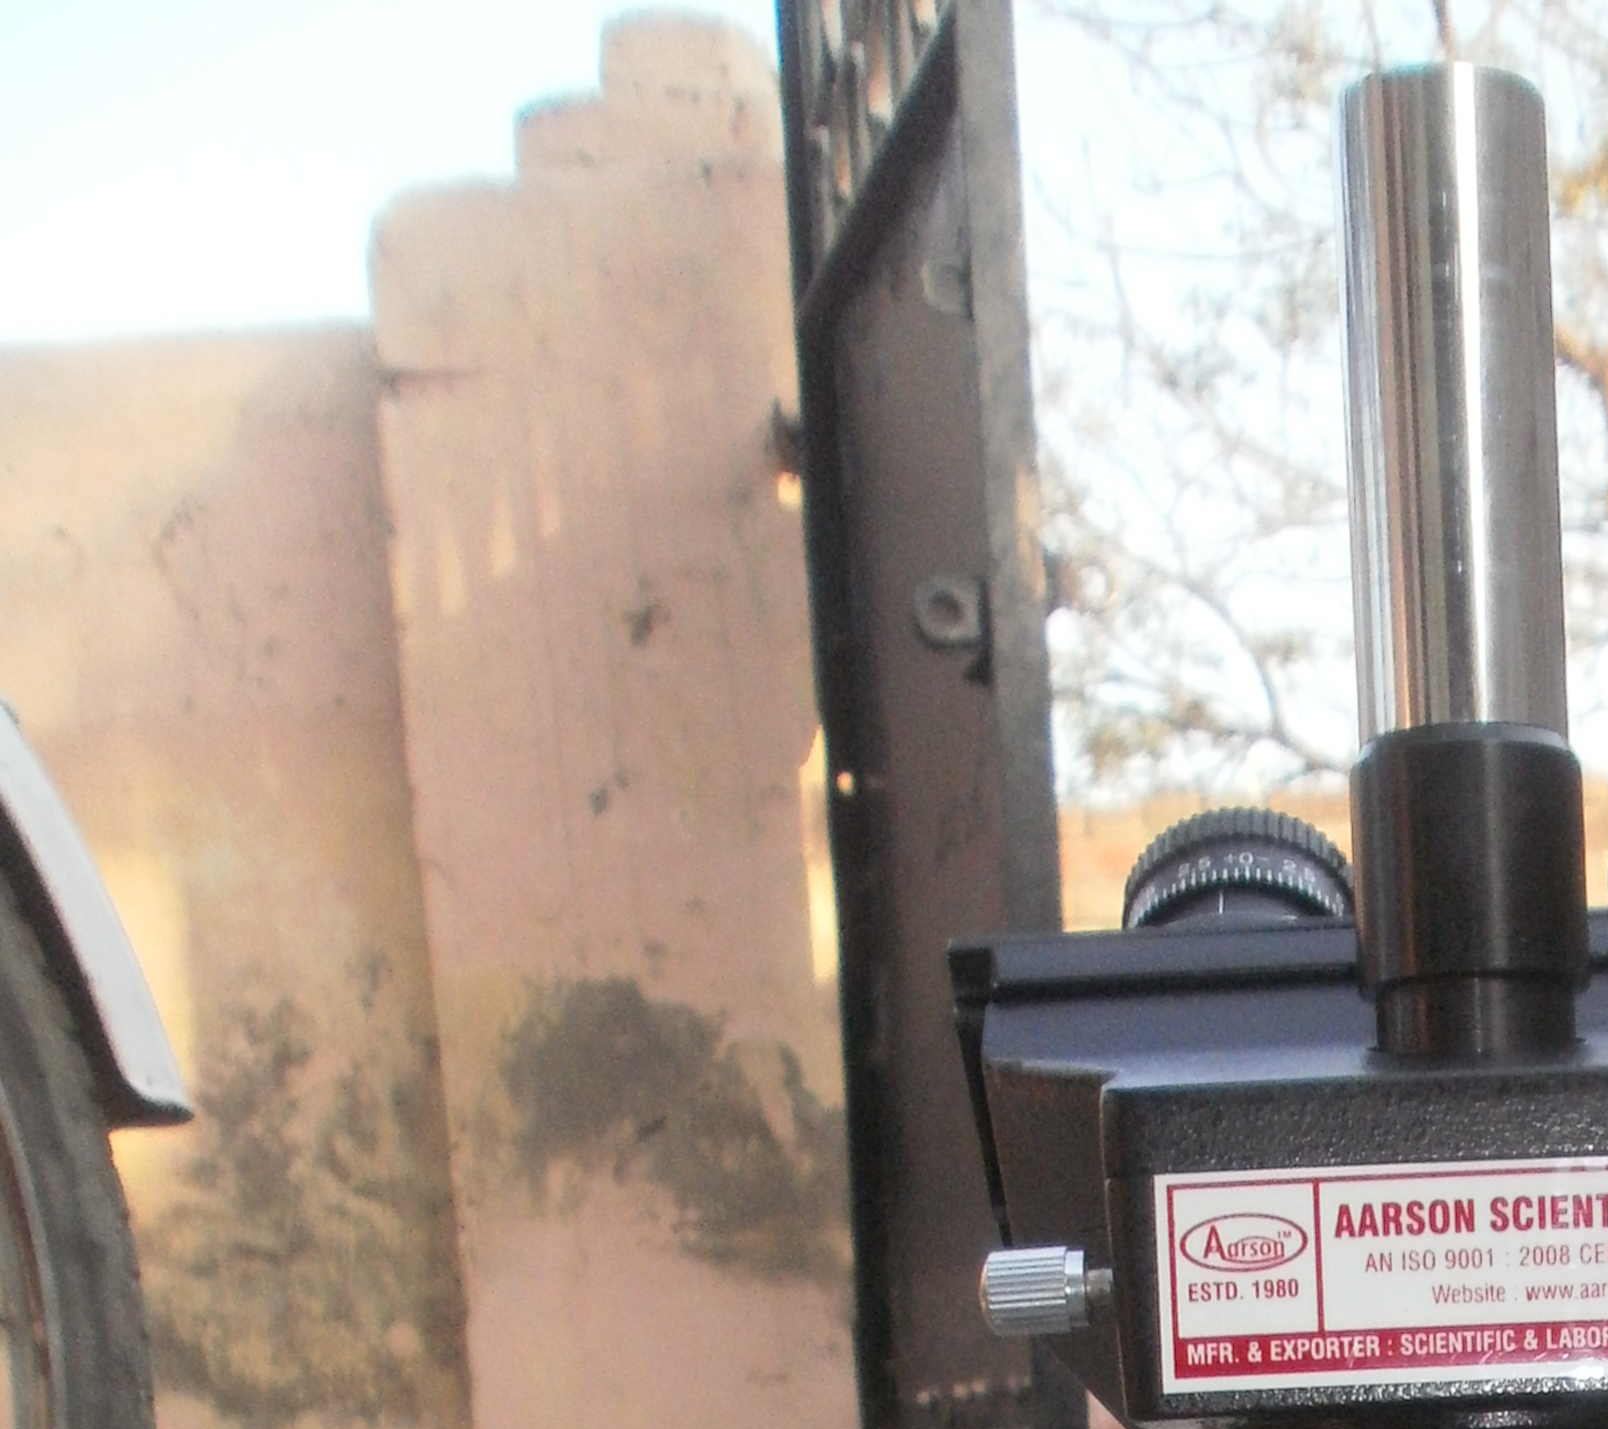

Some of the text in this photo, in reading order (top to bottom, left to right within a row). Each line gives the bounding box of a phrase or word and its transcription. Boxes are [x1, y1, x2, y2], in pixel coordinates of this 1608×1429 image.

[1334, 1199, 1476, 1238] AARSON
[1203, 1224, 1285, 1263] Aarson
[1365, 1251, 1393, 1273] AN
[1401, 1249, 1437, 1272] ISO
[1445, 1248, 1496, 1270] 9001
[1519, 1244, 1571, 1267] 2008
[1188, 1278, 1299, 1302] ESTD. 1980
[1432, 1282, 1507, 1304] Website
[1187, 1341, 1241, 1366] MFR.
[1247, 1340, 1263, 1363] &
[1270, 1335, 1382, 1361] EXPORTER
[1400, 1328, 1516, 1355] SCIENTIFIC
[1523, 1328, 1539, 1350] &
